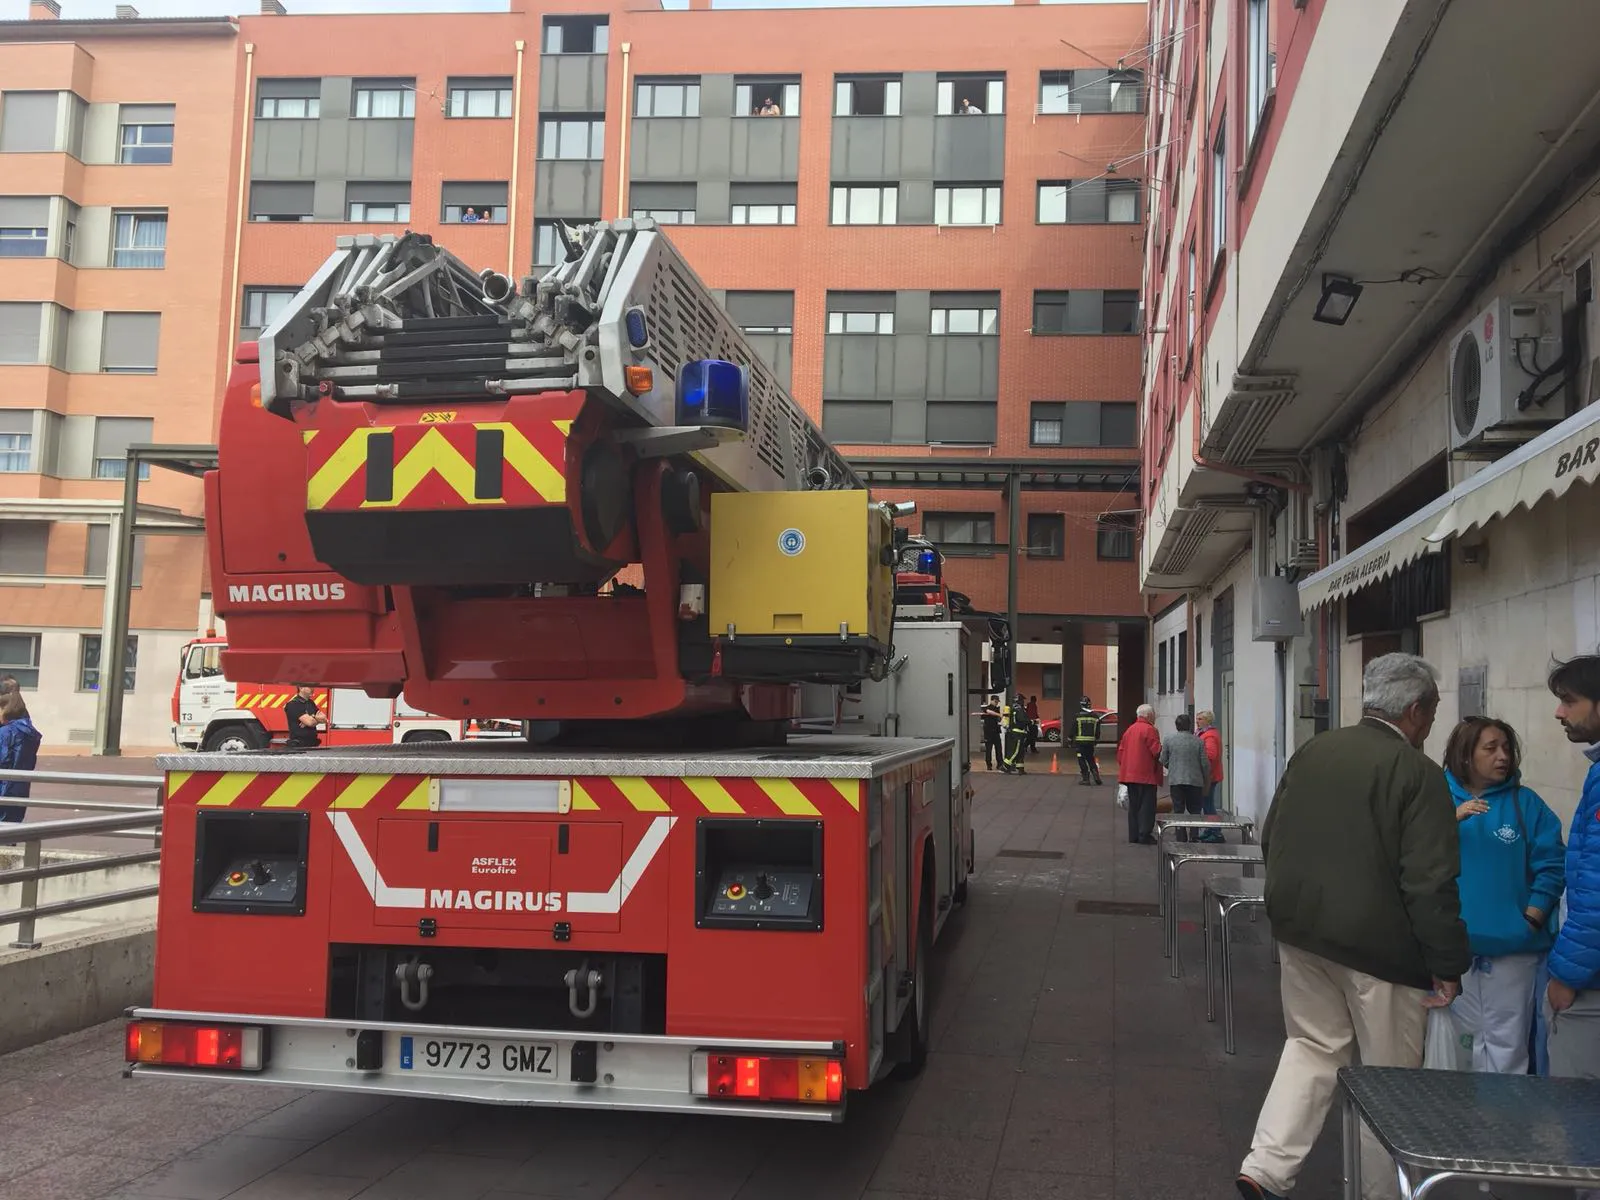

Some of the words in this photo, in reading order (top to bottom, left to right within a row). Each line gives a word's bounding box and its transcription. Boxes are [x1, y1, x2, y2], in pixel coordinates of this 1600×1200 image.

[1485, 346, 1494, 363] LG
[1555, 437, 1600, 478] BAR
[1328, 577, 1342, 593] BAR
[1342, 566, 1360, 587] PEÑA
[228, 583, 346, 603] MAGIRUS
[182, 713, 193, 721] T3
[471, 866, 517, 875] Eurofire
[472, 857, 517, 867] ASFLEX
[430, 889, 562, 912] MAGIRUS
[403, 1056, 410, 1064] E
[426, 1041, 491, 1070] 9773
[502, 1045, 552, 1073] GMZ
